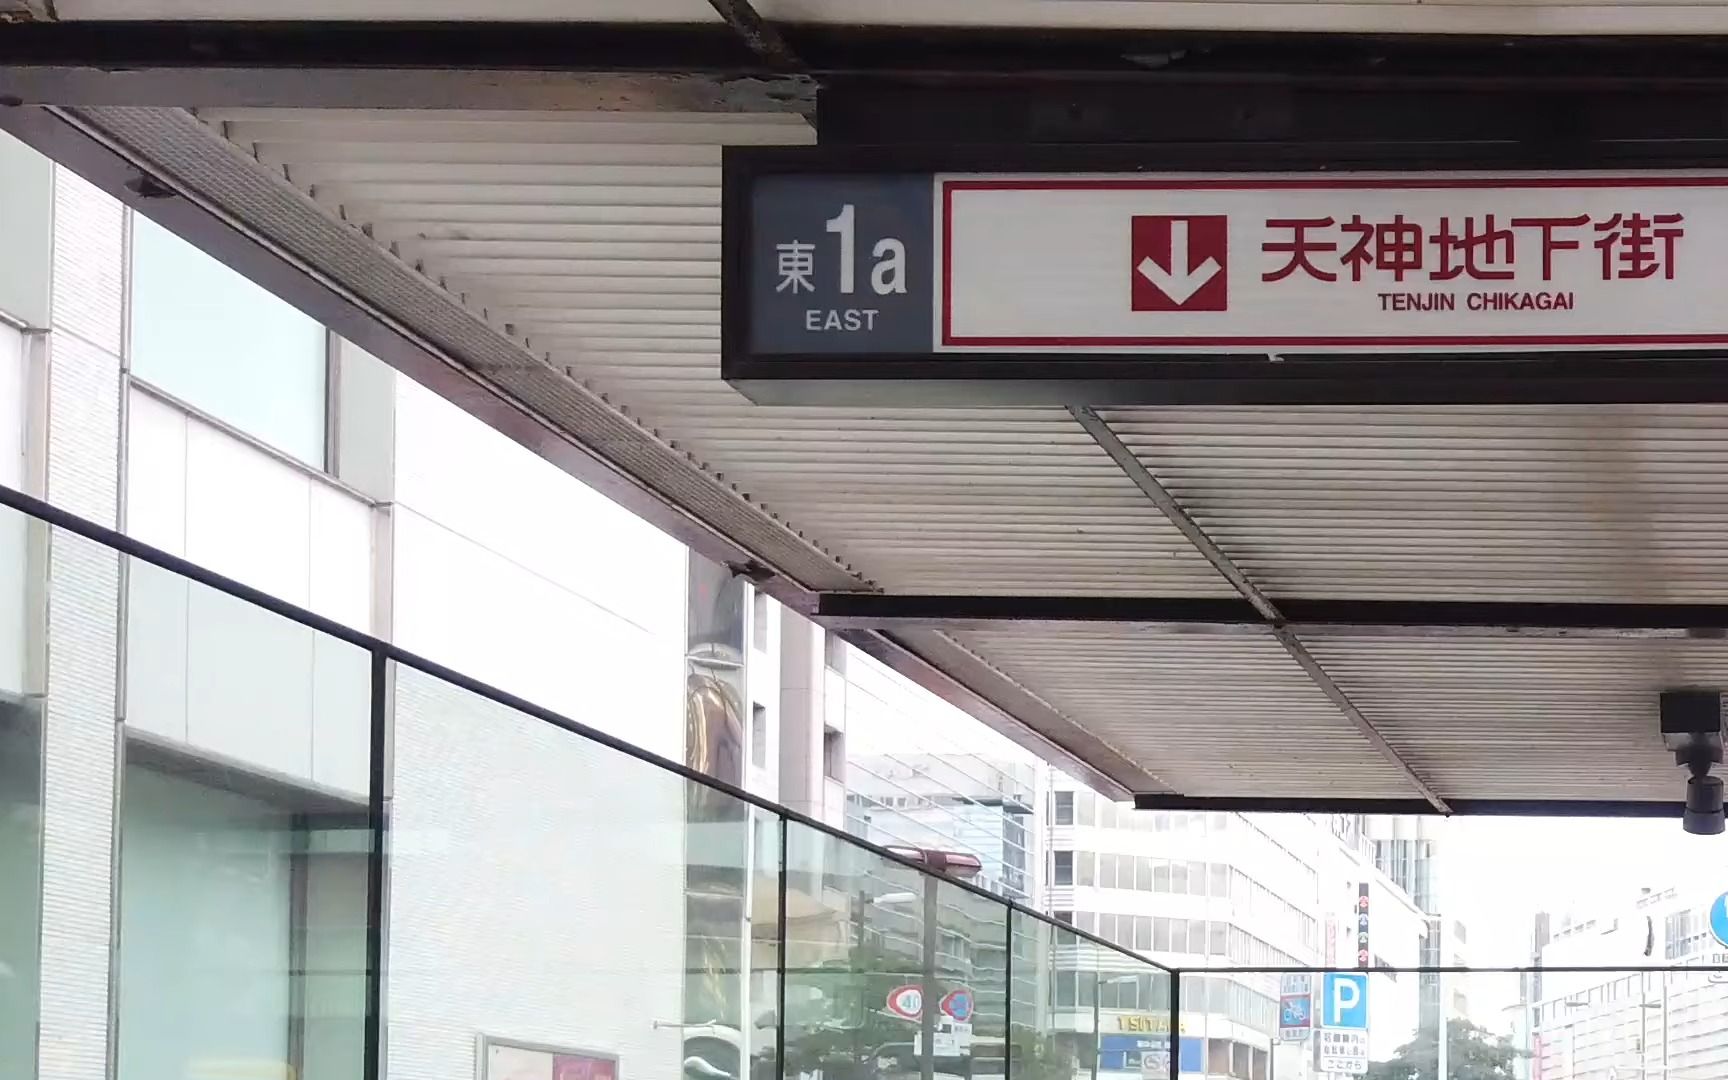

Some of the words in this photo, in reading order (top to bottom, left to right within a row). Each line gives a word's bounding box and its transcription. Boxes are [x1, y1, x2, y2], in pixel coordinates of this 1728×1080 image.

[776, 240, 816, 294] 東
[826, 204, 908, 296] 1a
[1261, 212, 1684, 283] 天神地下街
[806, 308, 879, 331] EAST
[1377, 292, 1455, 311] TENJIN
[1466, 291, 1574, 311] CHIKAGAI
[1333, 977, 1361, 1024] P
